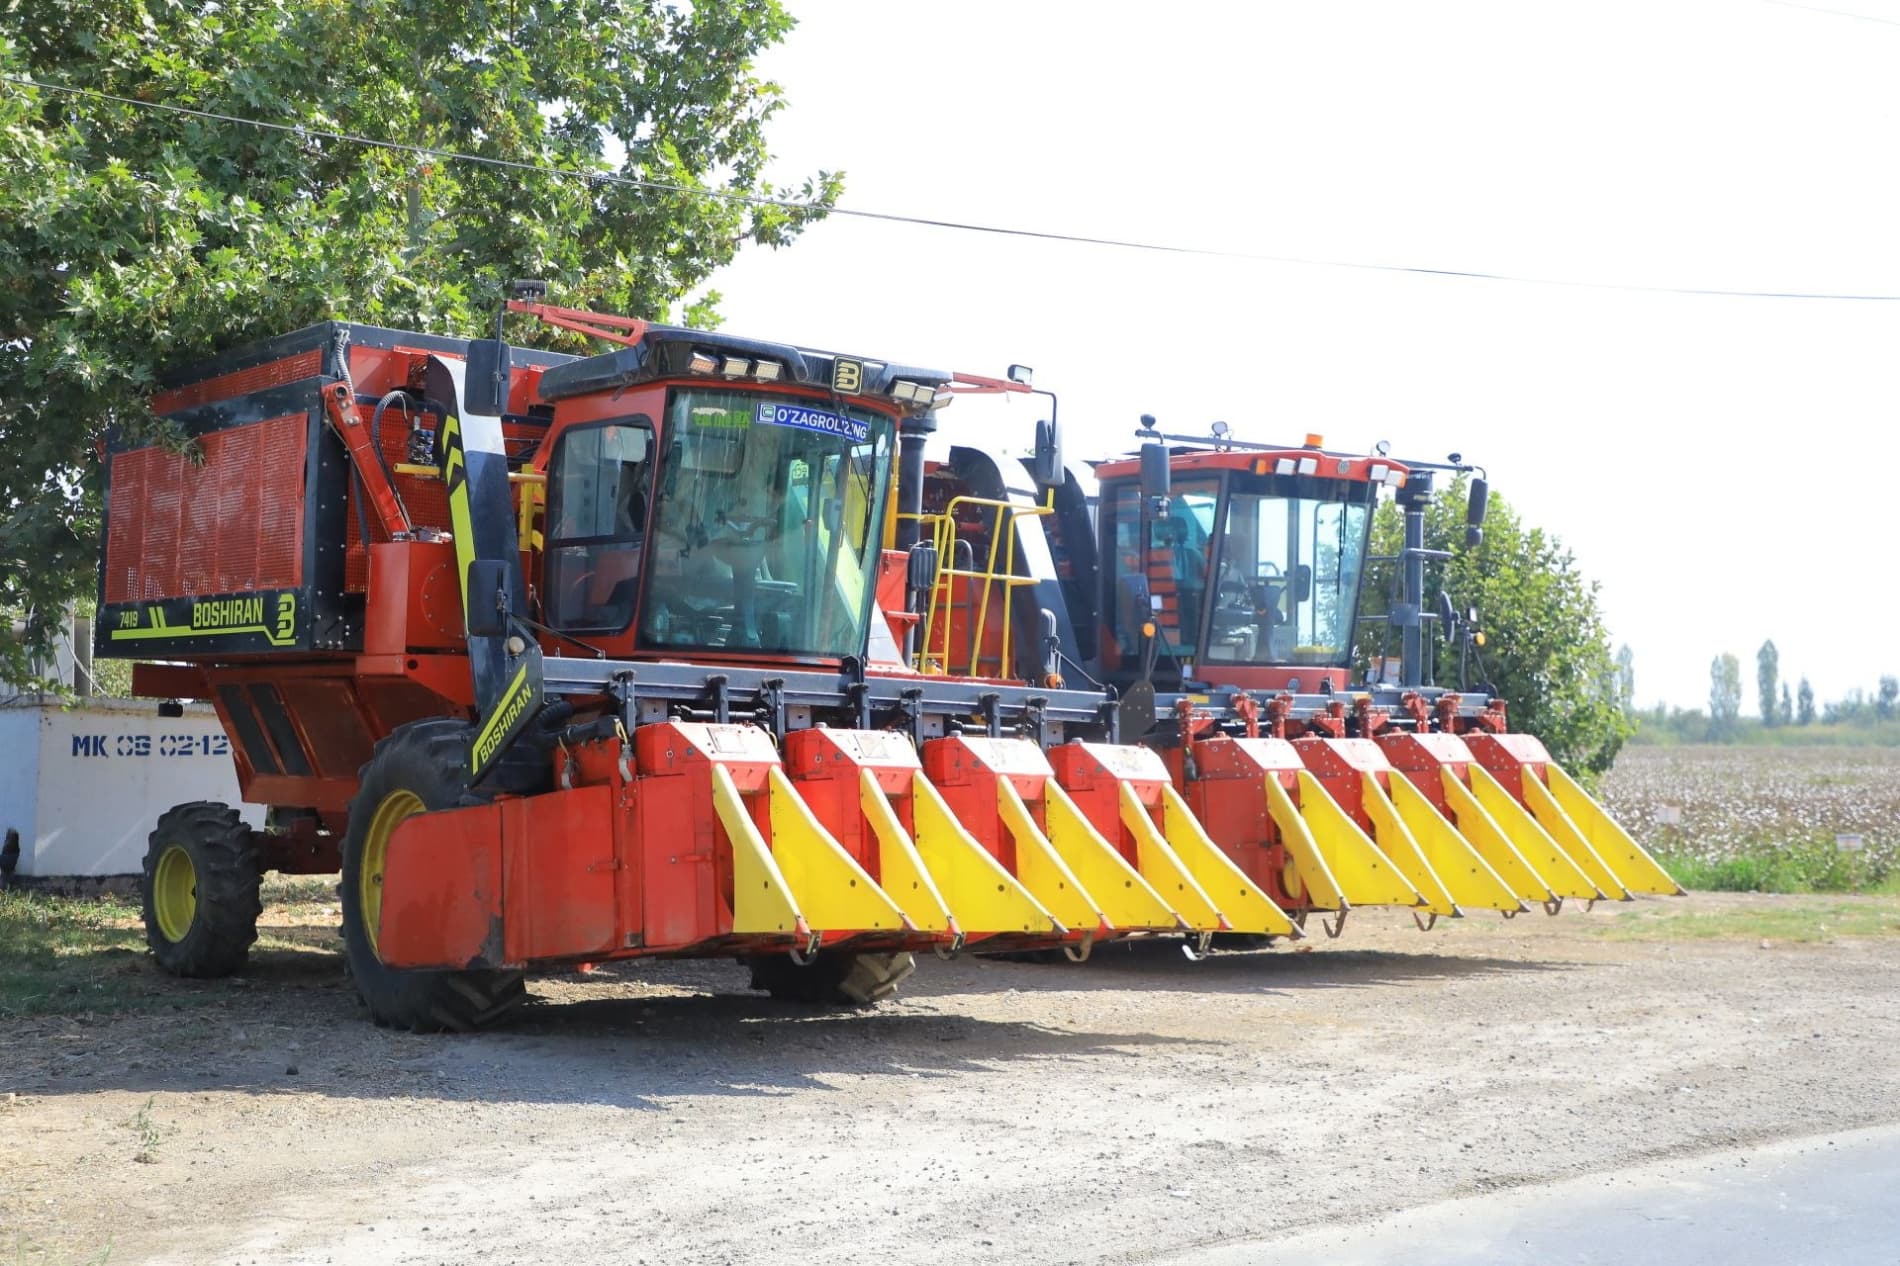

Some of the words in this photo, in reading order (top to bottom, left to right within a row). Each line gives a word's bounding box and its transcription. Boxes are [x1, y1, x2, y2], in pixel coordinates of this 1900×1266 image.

[120, 611, 138, 628] 7419
[193, 598, 263, 627] BOSHIRAN
[480, 683, 532, 764] BOSHIRAN
